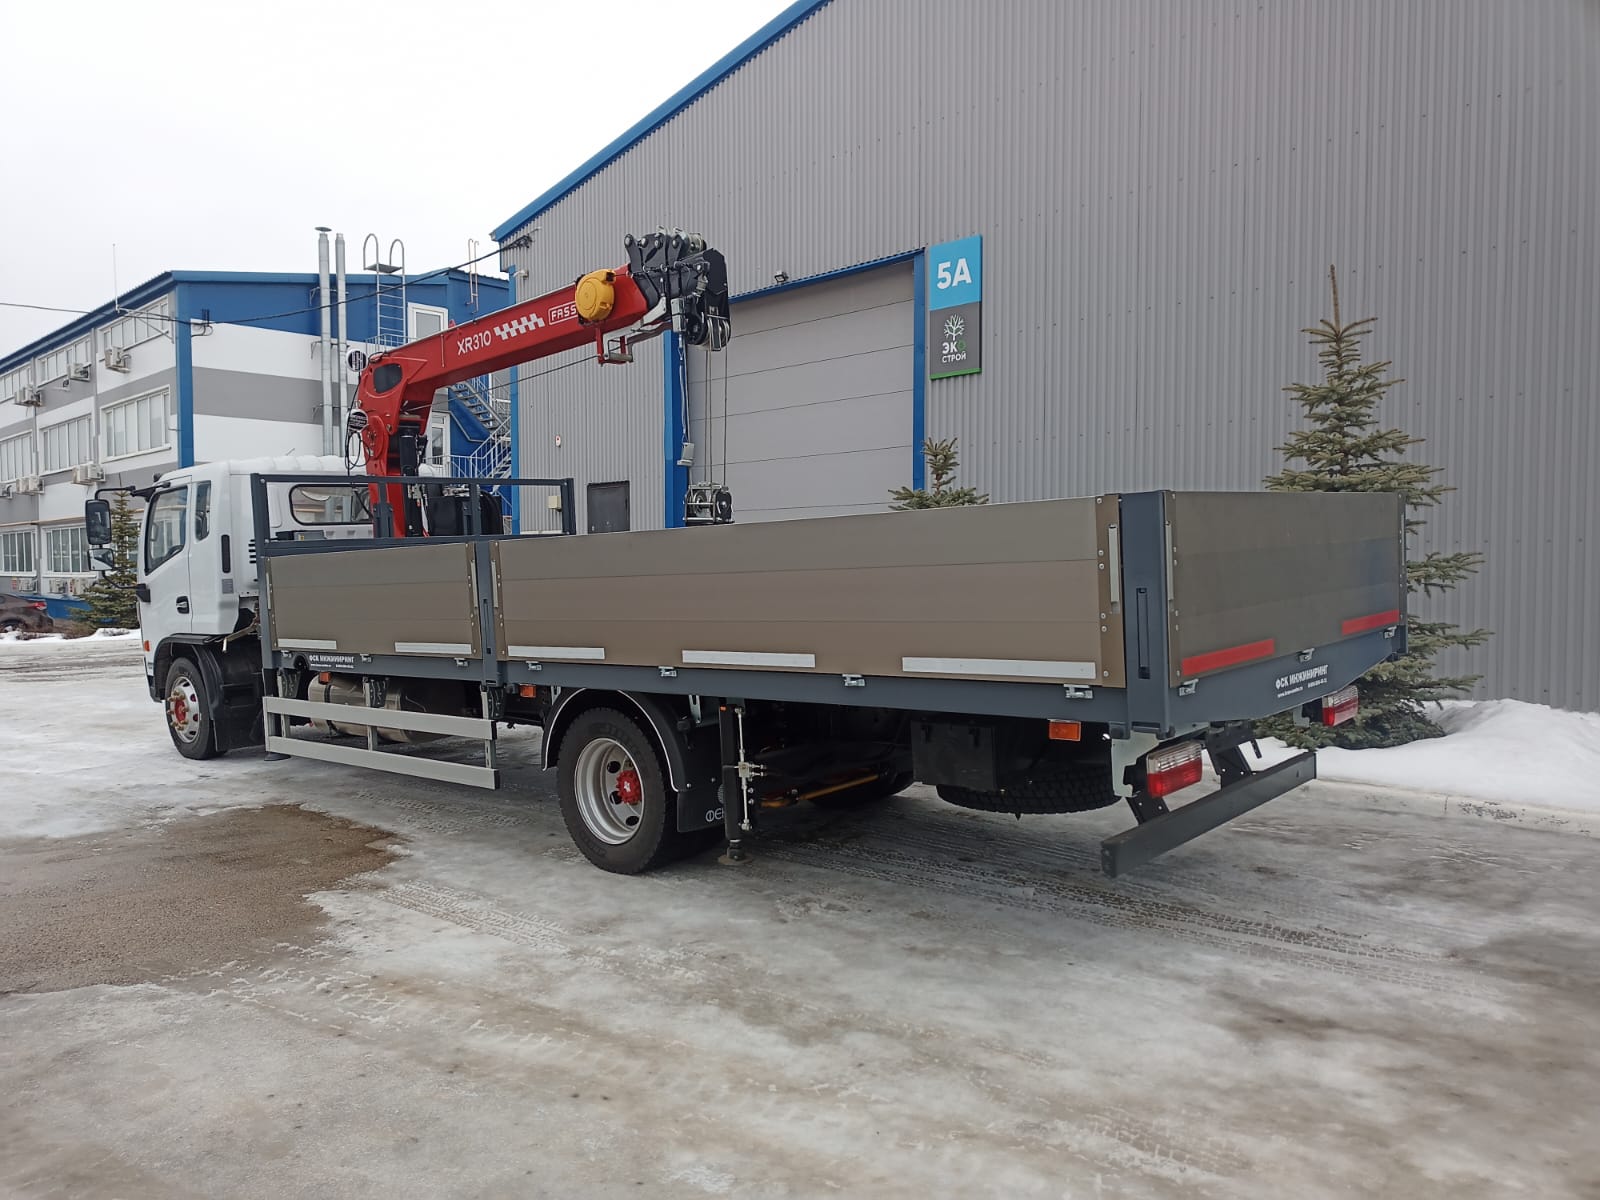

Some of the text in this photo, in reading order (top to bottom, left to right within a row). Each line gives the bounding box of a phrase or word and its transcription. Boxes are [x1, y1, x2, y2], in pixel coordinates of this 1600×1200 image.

[936, 257, 973, 290] 5А
[551, 304, 578, 321] FASS
[457, 330, 492, 356] XR310
[942, 350, 967, 363] СТРОЙ
[1275, 675, 1289, 690] ФСК
